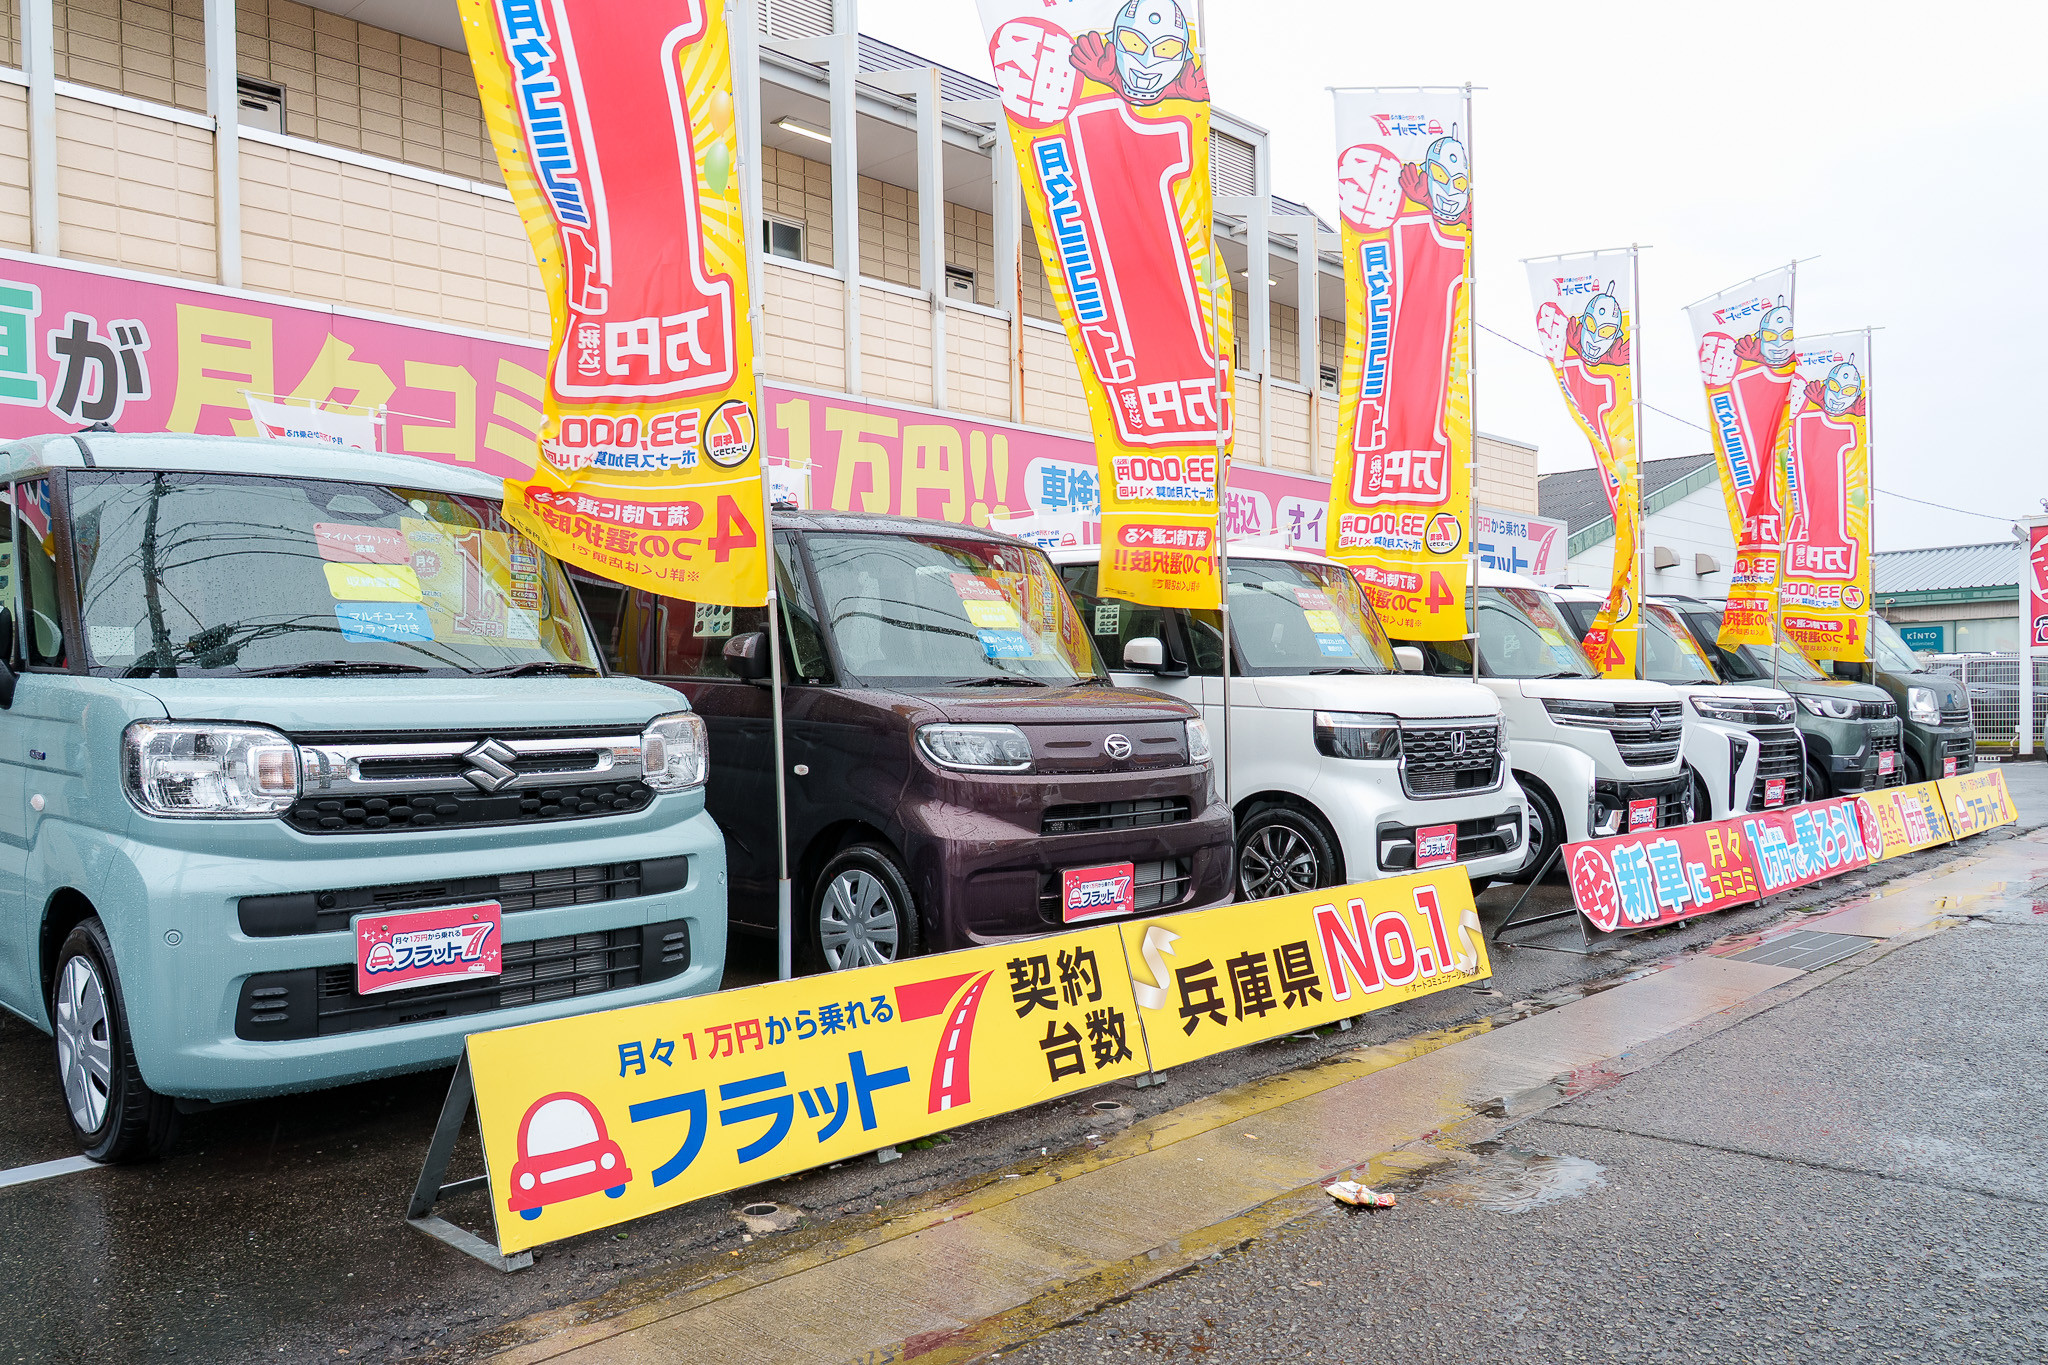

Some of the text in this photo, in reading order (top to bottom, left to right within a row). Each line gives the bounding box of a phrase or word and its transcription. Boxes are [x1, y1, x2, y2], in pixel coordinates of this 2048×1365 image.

[349, 611, 417, 622] マルチユース
[1574, 837, 1714, 930] 軽 新車に
[1705, 827, 1758, 900] 月々 コミコミ
[394, 929, 462, 944] 月々1万円から乗れる
[395, 924, 492, 965] フラット7
[1174, 884, 1455, 1038] 兵庫県 No.1
[1004, 945, 1100, 1018] 契約
[617, 993, 894, 1079] 月々1万円から乗れる
[1038, 1006, 1133, 1082] 台数
